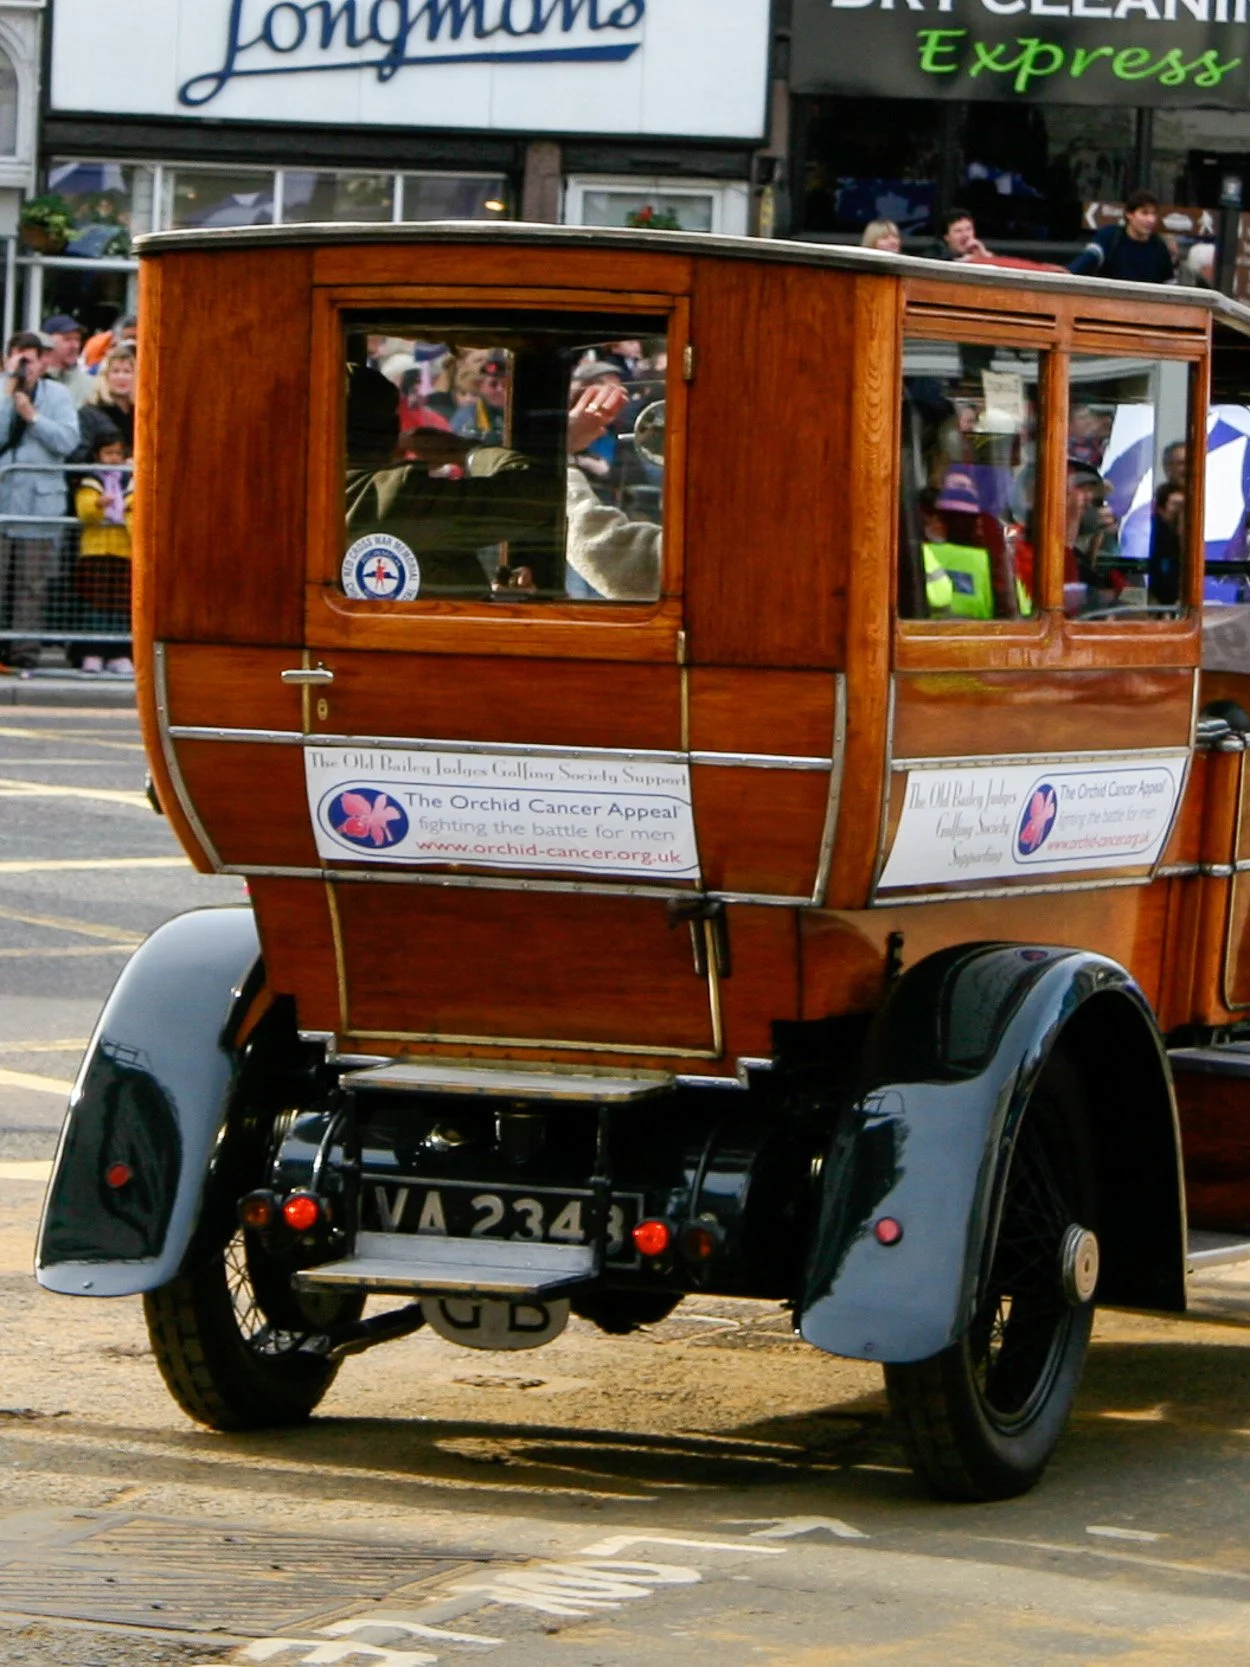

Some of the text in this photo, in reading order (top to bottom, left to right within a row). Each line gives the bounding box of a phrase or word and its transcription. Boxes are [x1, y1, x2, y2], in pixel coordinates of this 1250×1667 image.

[177, 0, 646, 107] Longmans
[916, 28, 1241, 93] Express
[309, 751, 687, 787] The Old Bailey Judges Golfing Society Support
[404, 791, 678, 821] The Orchid Cancer Appeal
[419, 815, 675, 841] fighting the battle for men
[416, 840, 681, 866] www.orchid-cancer.org.uk
[374, 1185, 449, 1237] VA
